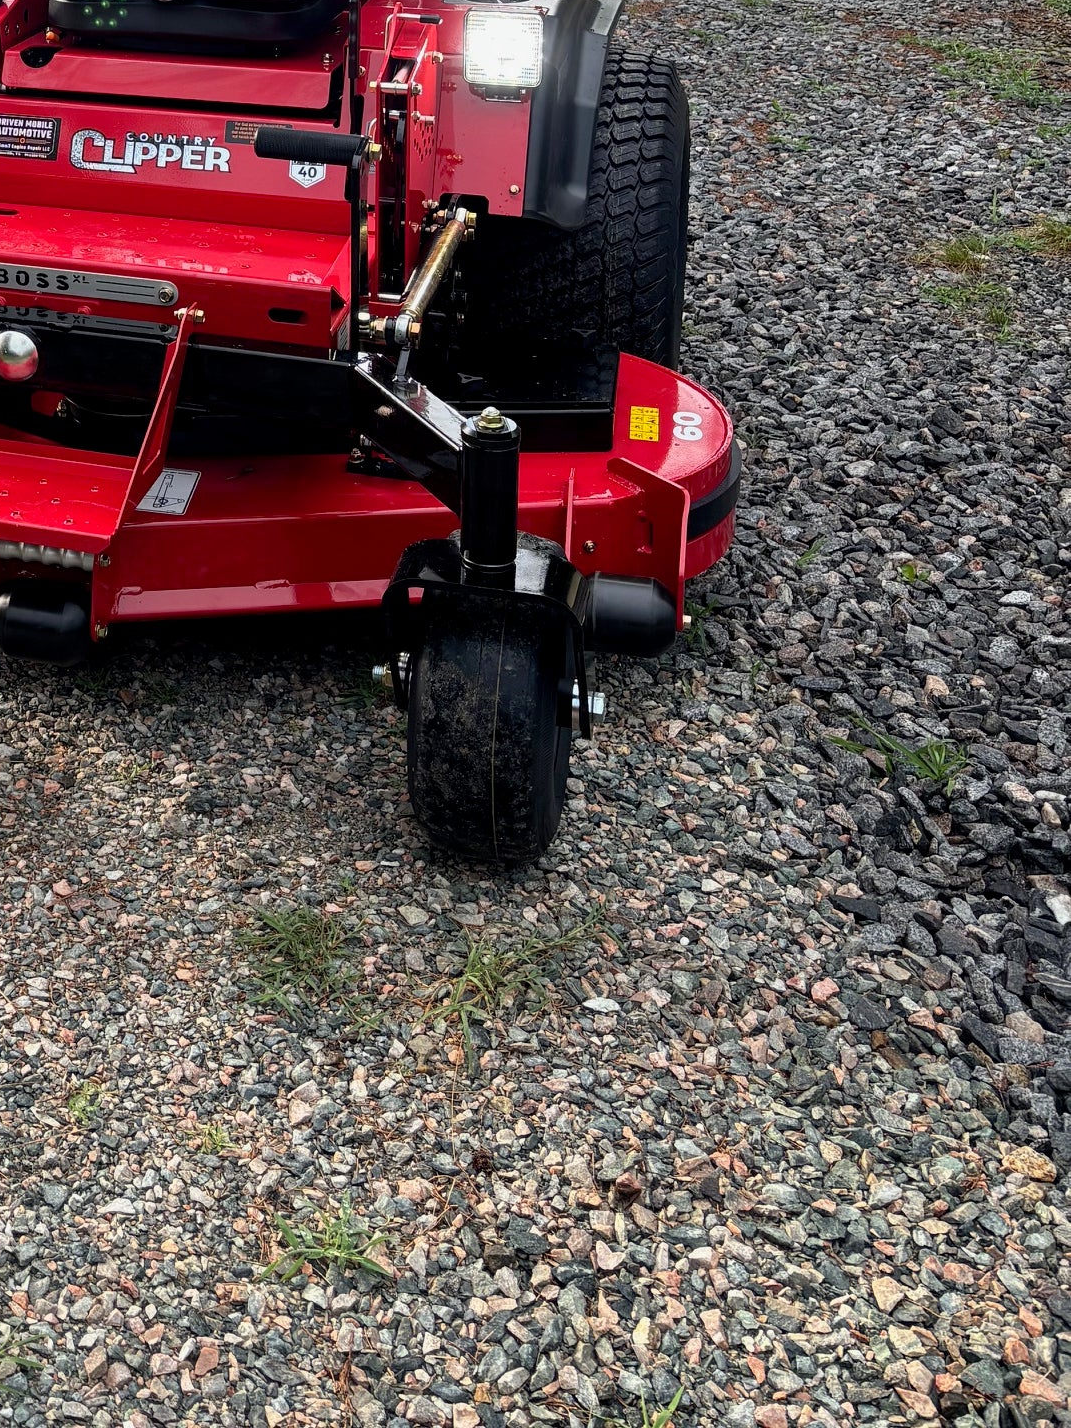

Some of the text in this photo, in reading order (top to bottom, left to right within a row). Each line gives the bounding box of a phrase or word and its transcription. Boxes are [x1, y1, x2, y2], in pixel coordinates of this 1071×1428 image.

[25, 120, 53, 129] MOBILE
[126, 132, 217, 146] COUNTRY
[70, 128, 231, 174] CLIPPER
[298, 166, 318, 179] 40
[72, 274, 90, 285] XL
[672, 411, 703, 442] 60
